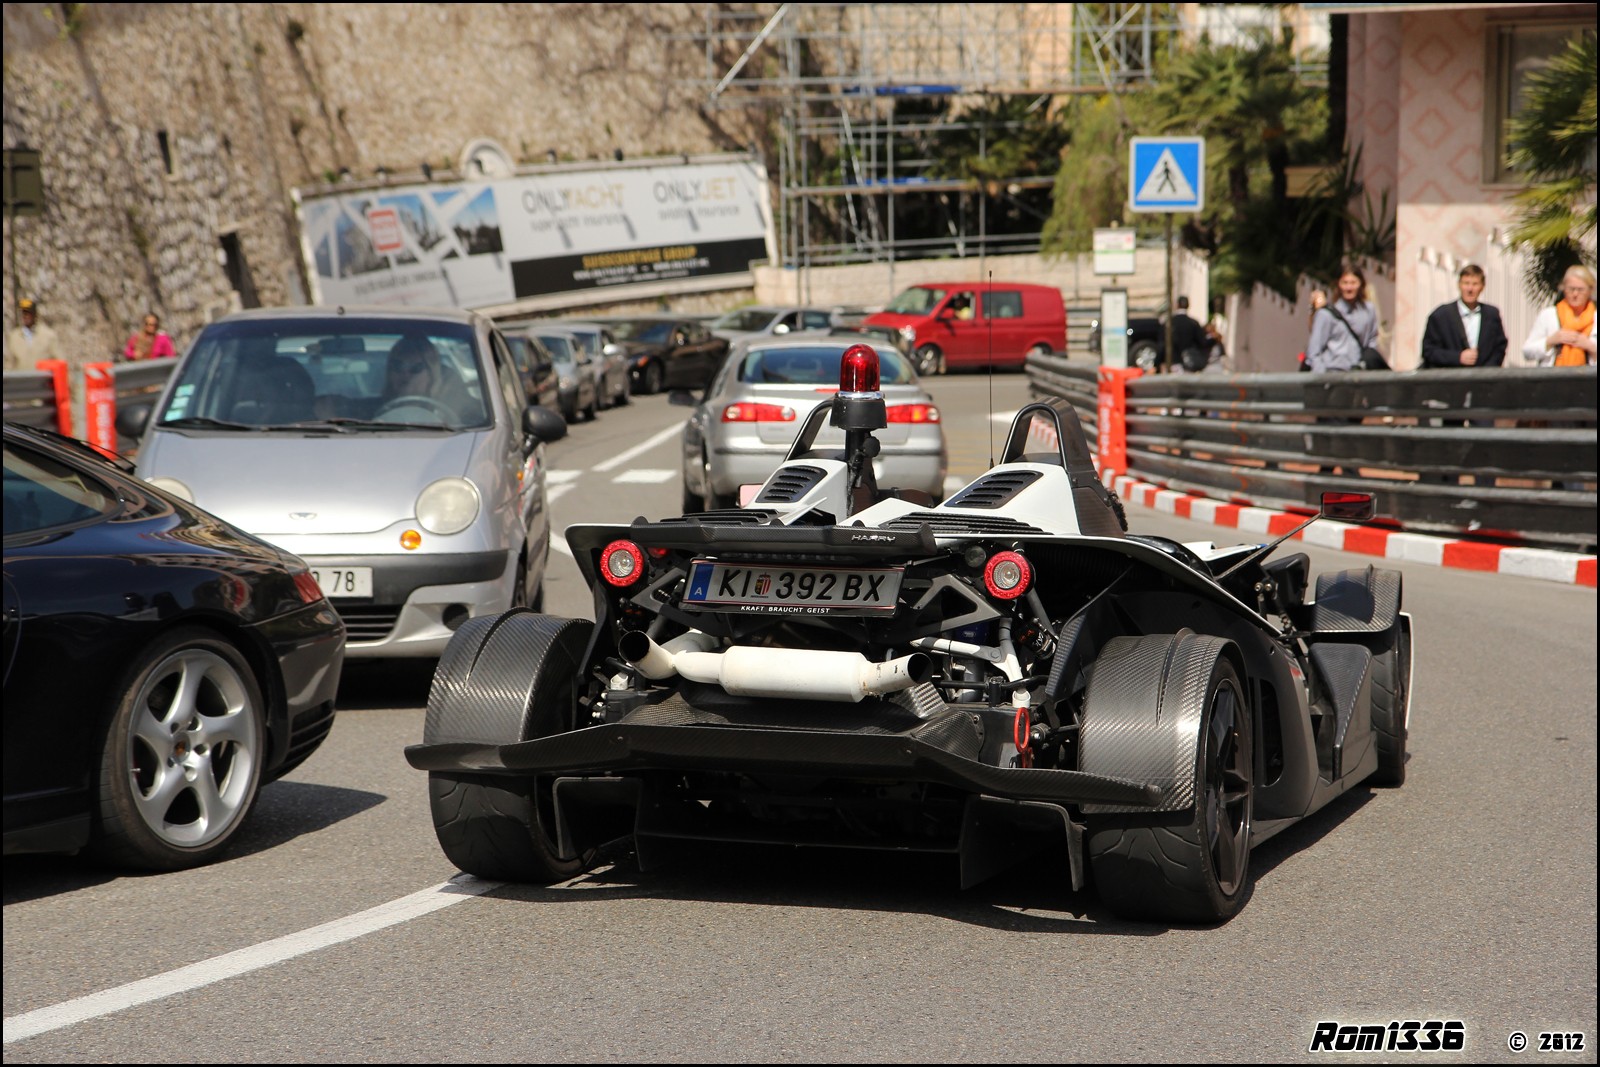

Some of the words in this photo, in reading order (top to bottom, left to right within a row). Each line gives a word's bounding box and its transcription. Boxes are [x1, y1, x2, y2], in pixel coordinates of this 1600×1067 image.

[653, 176, 737, 204] ONLYJET
[851, 534, 896, 542] HARRY
[332, 571, 354, 592] 78
[694, 586, 702, 595] A
[719, 569, 752, 597] KI
[776, 571, 837, 600] 392
[842, 574, 886, 602] BX
